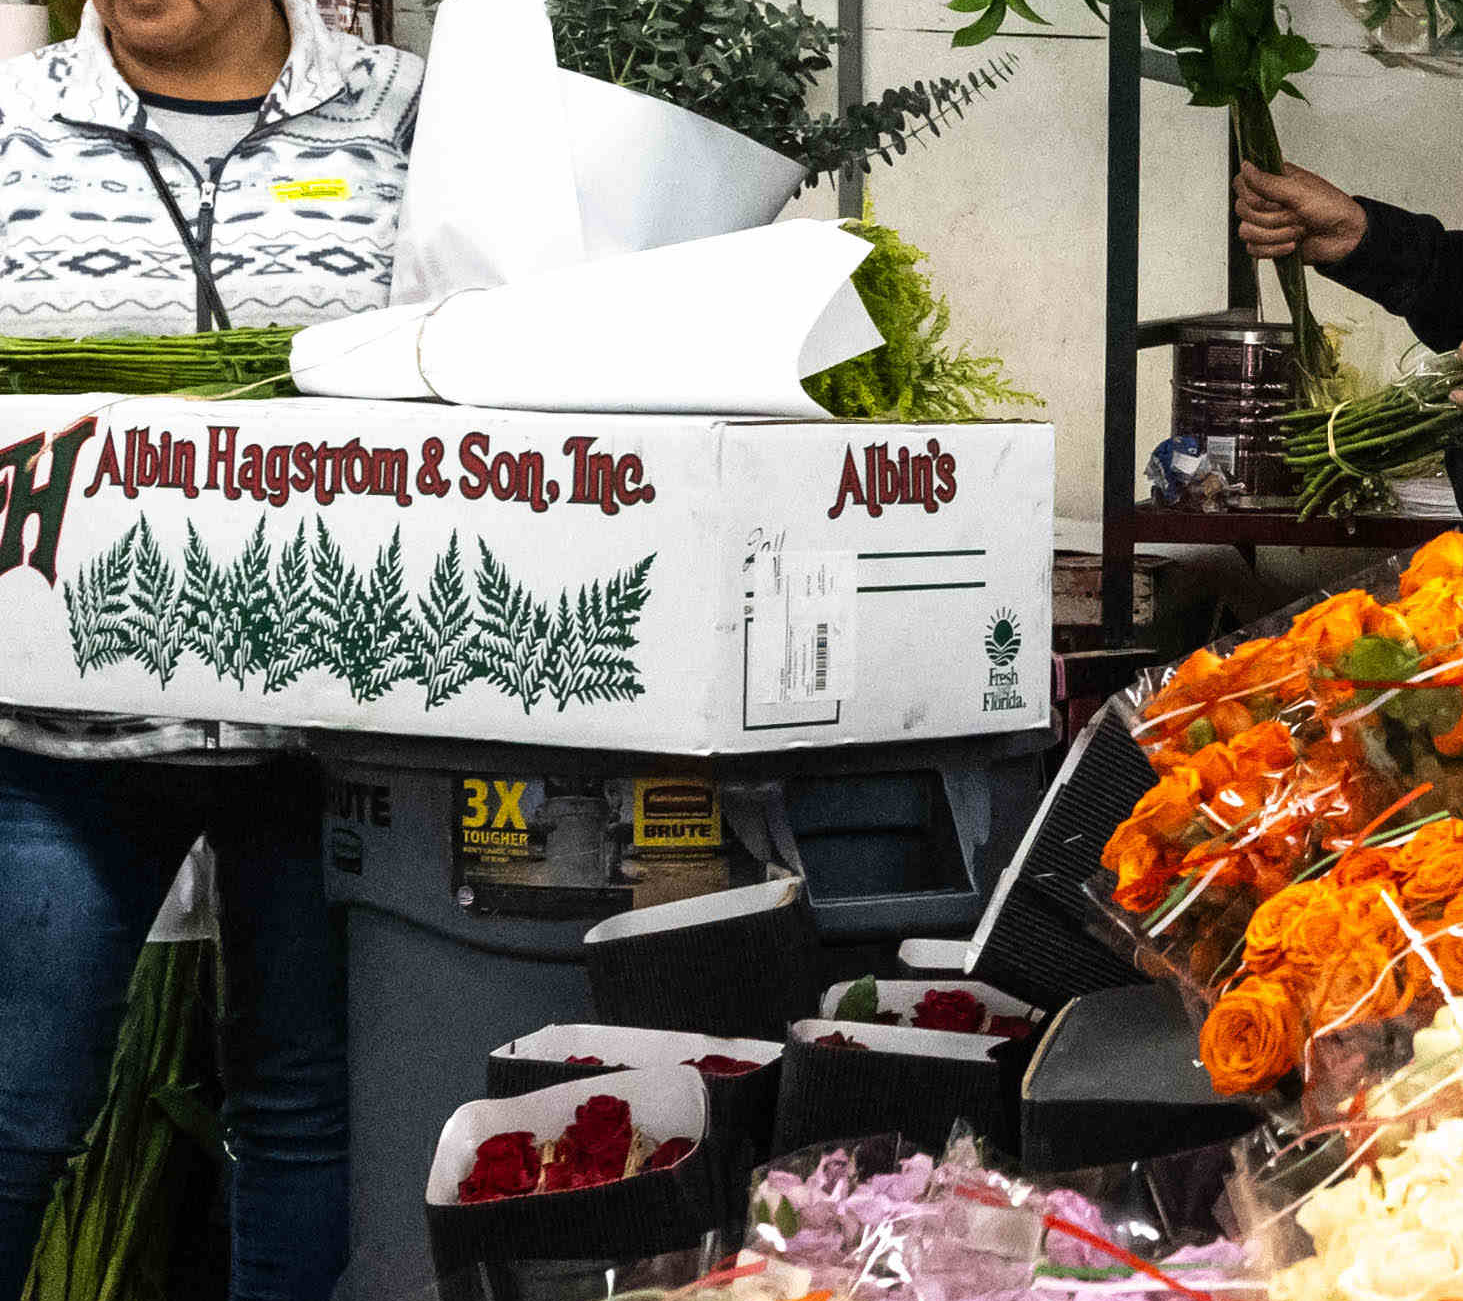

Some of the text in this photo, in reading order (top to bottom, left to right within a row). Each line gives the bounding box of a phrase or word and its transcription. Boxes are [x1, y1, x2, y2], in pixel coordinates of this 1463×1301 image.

[84, 424, 200, 499] Albin
[202, 424, 414, 508] Hagstrom
[417, 436, 451, 499] &
[457, 430, 559, 514] Son,
[563, 436, 656, 516] Inc.
[827, 437, 957, 520] Albin's
[988, 666, 1019, 687] Fresh
[462, 778, 529, 830] 3X
[463, 829, 529, 846] TOUGHER
[643, 822, 713, 839] BRUTE
